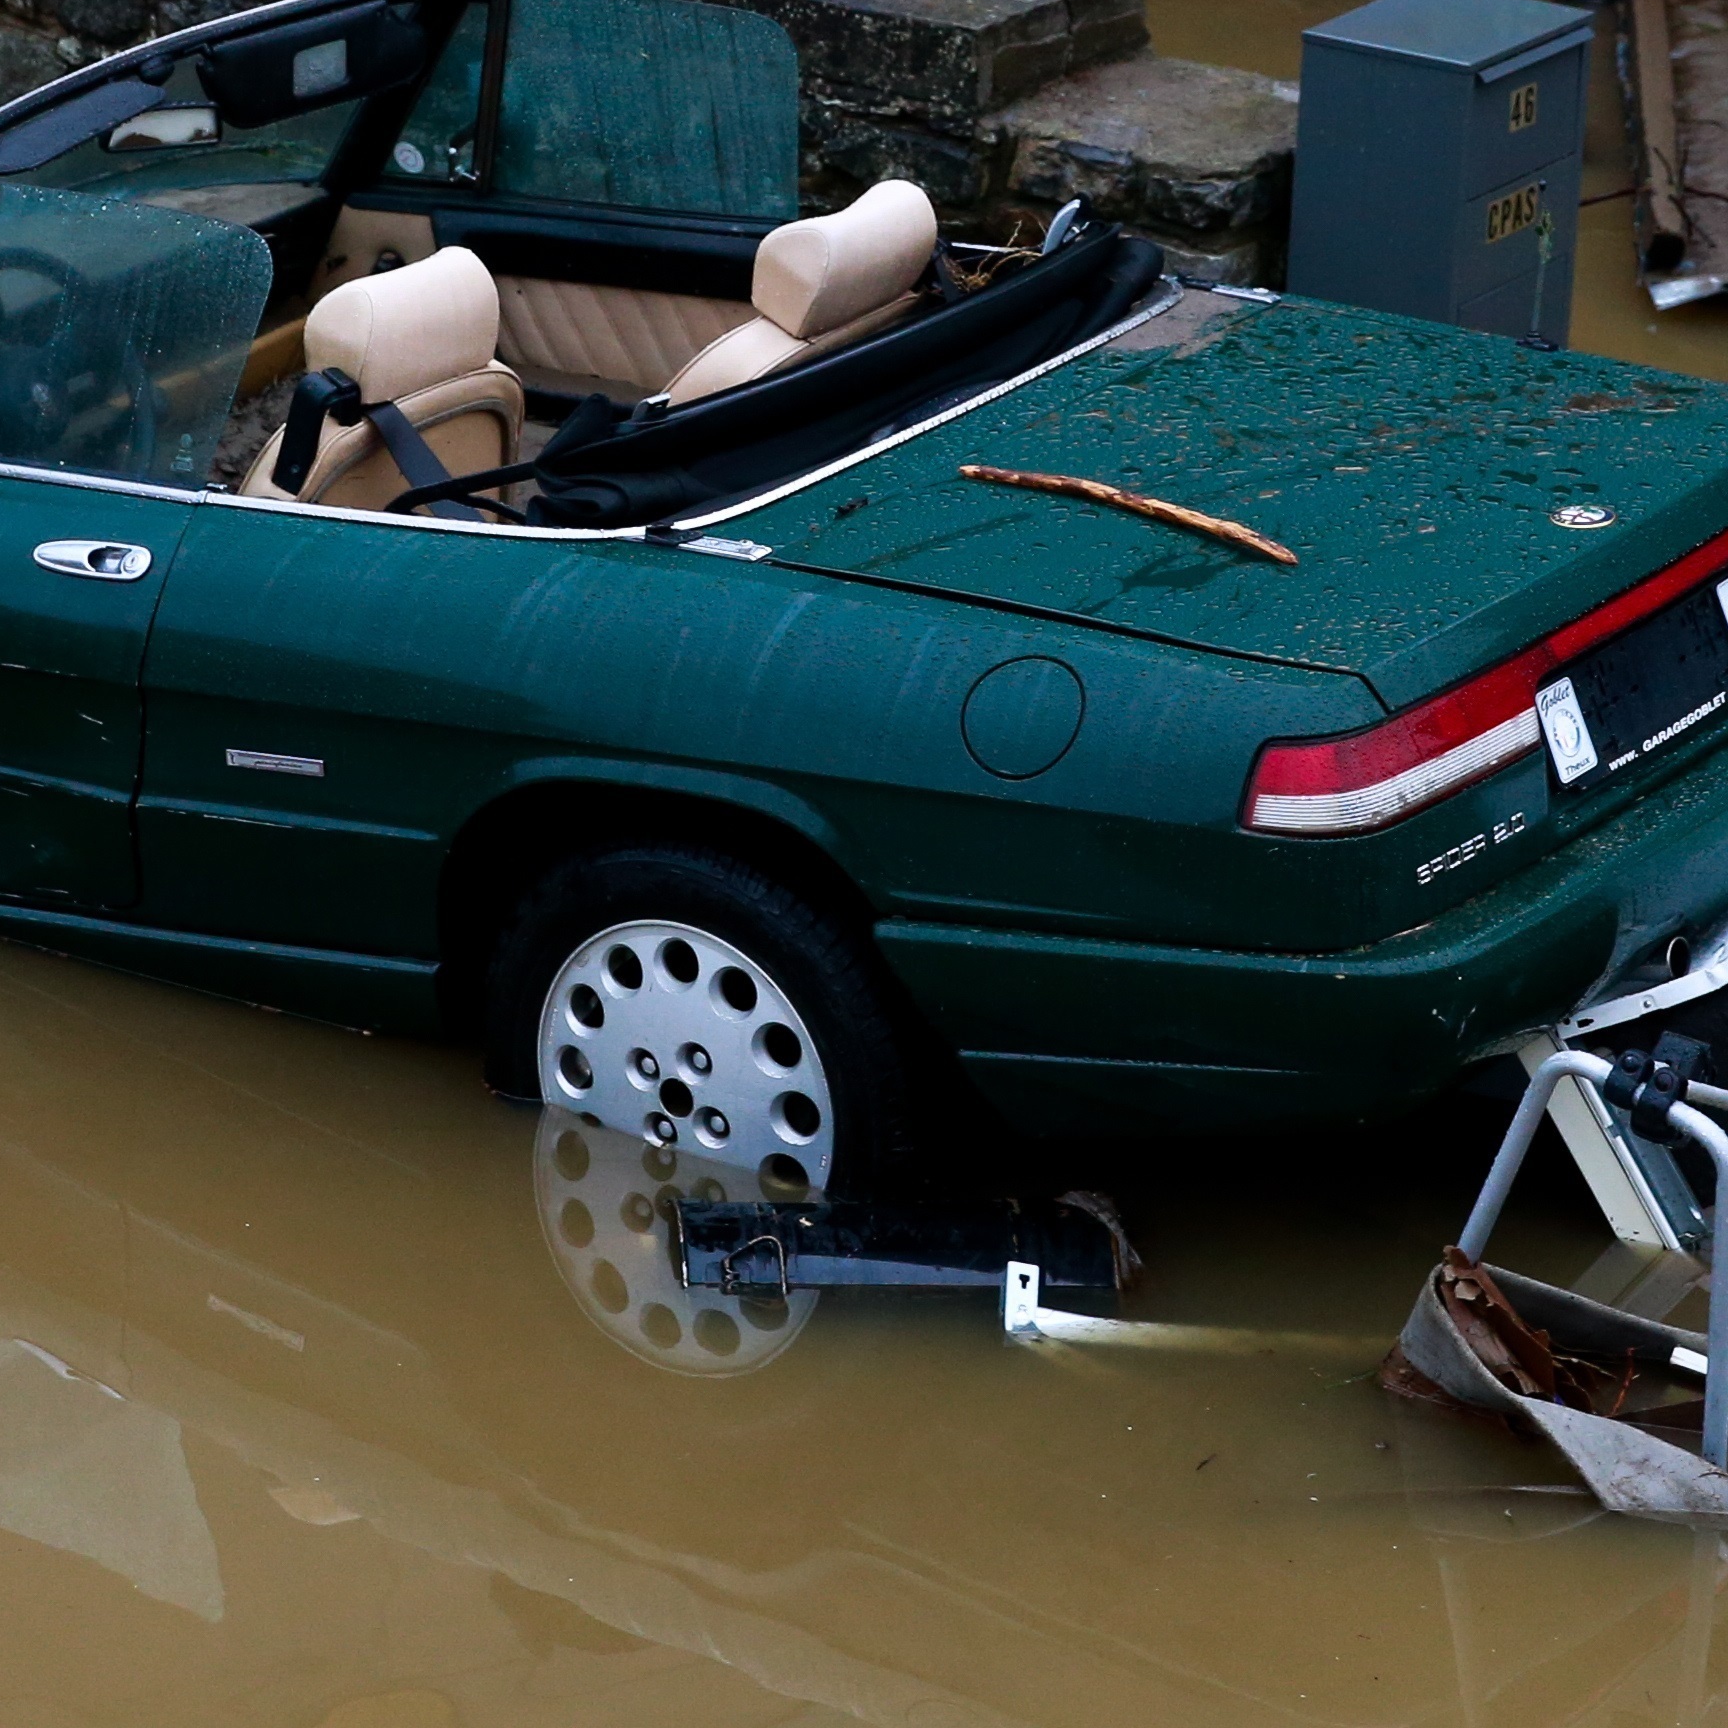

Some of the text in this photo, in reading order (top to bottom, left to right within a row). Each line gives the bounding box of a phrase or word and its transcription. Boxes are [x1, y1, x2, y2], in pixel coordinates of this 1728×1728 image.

[1511, 87, 1536, 127] 46
[1487, 186, 1537, 240] CPAS
[1541, 684, 1570, 719] Goblet
[1642, 691, 1726, 752] GARAGEGOBLET
[1565, 756, 1591, 776] Theux
[1417, 834, 1487, 886] SPIDER
